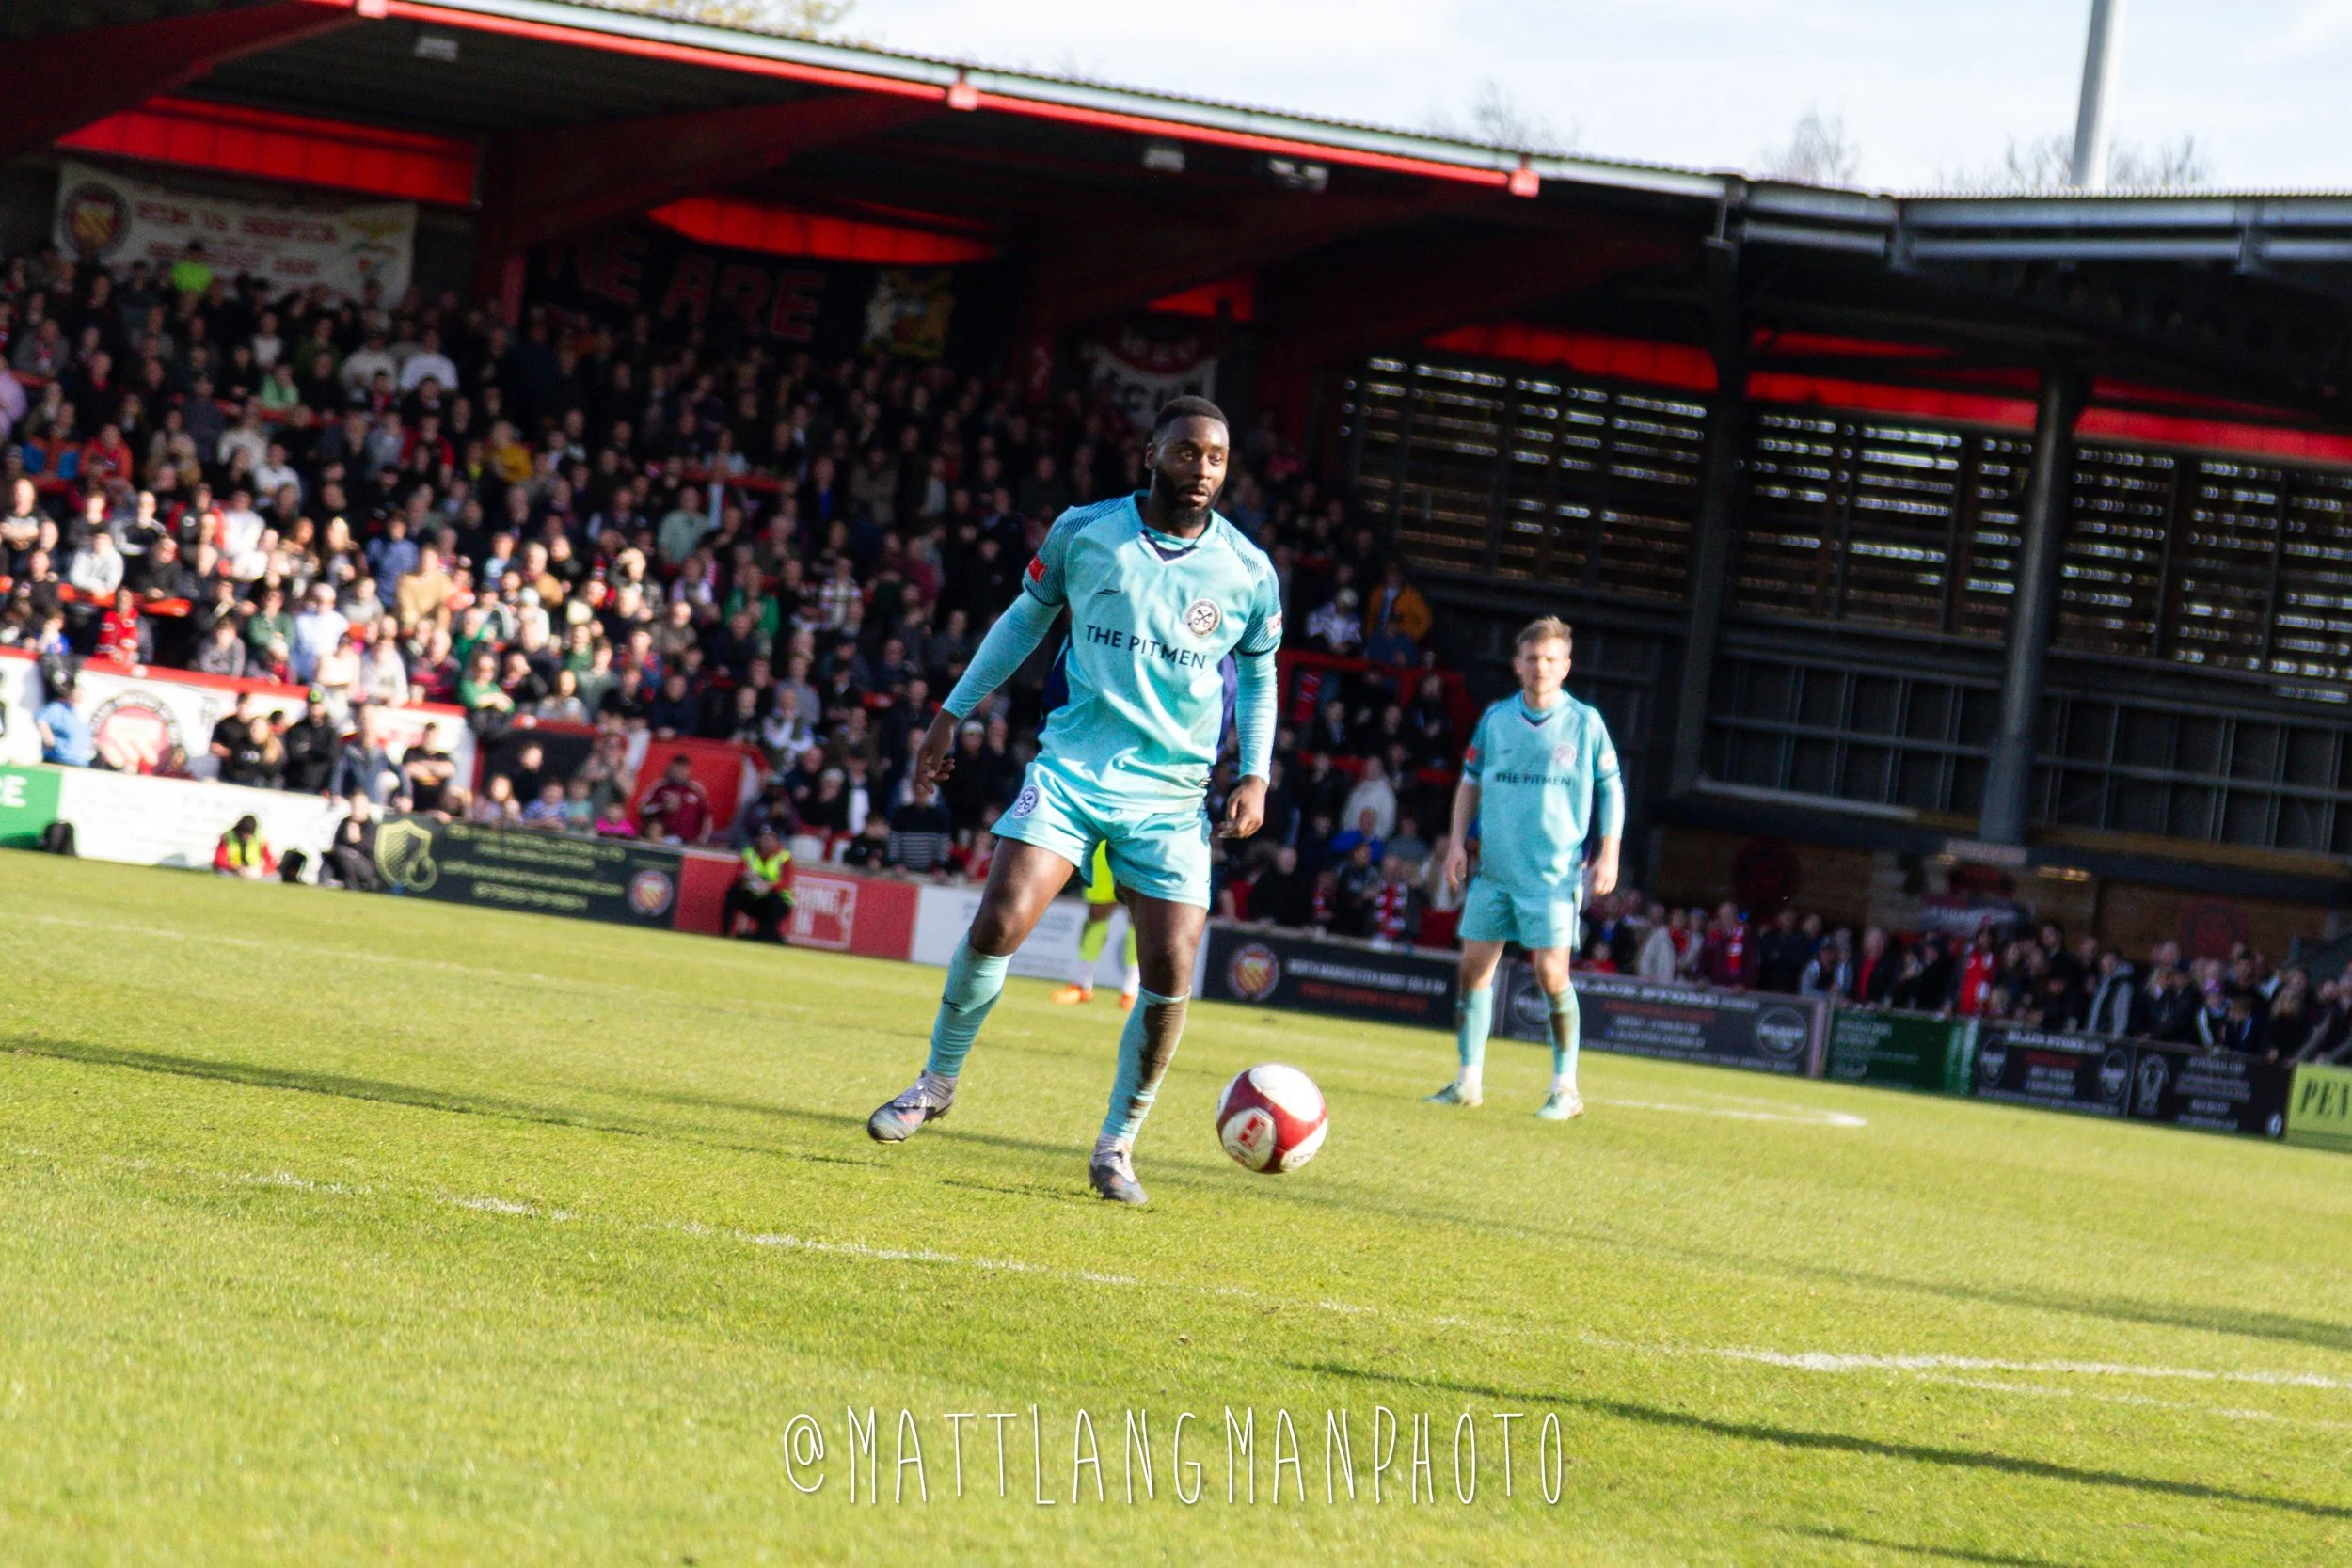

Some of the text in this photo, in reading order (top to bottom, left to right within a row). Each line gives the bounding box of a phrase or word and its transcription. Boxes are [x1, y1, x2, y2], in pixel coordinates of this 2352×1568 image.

[1085, 625, 1206, 670] THE PITMEN
[1494, 771, 1572, 787] THE PITMEN
